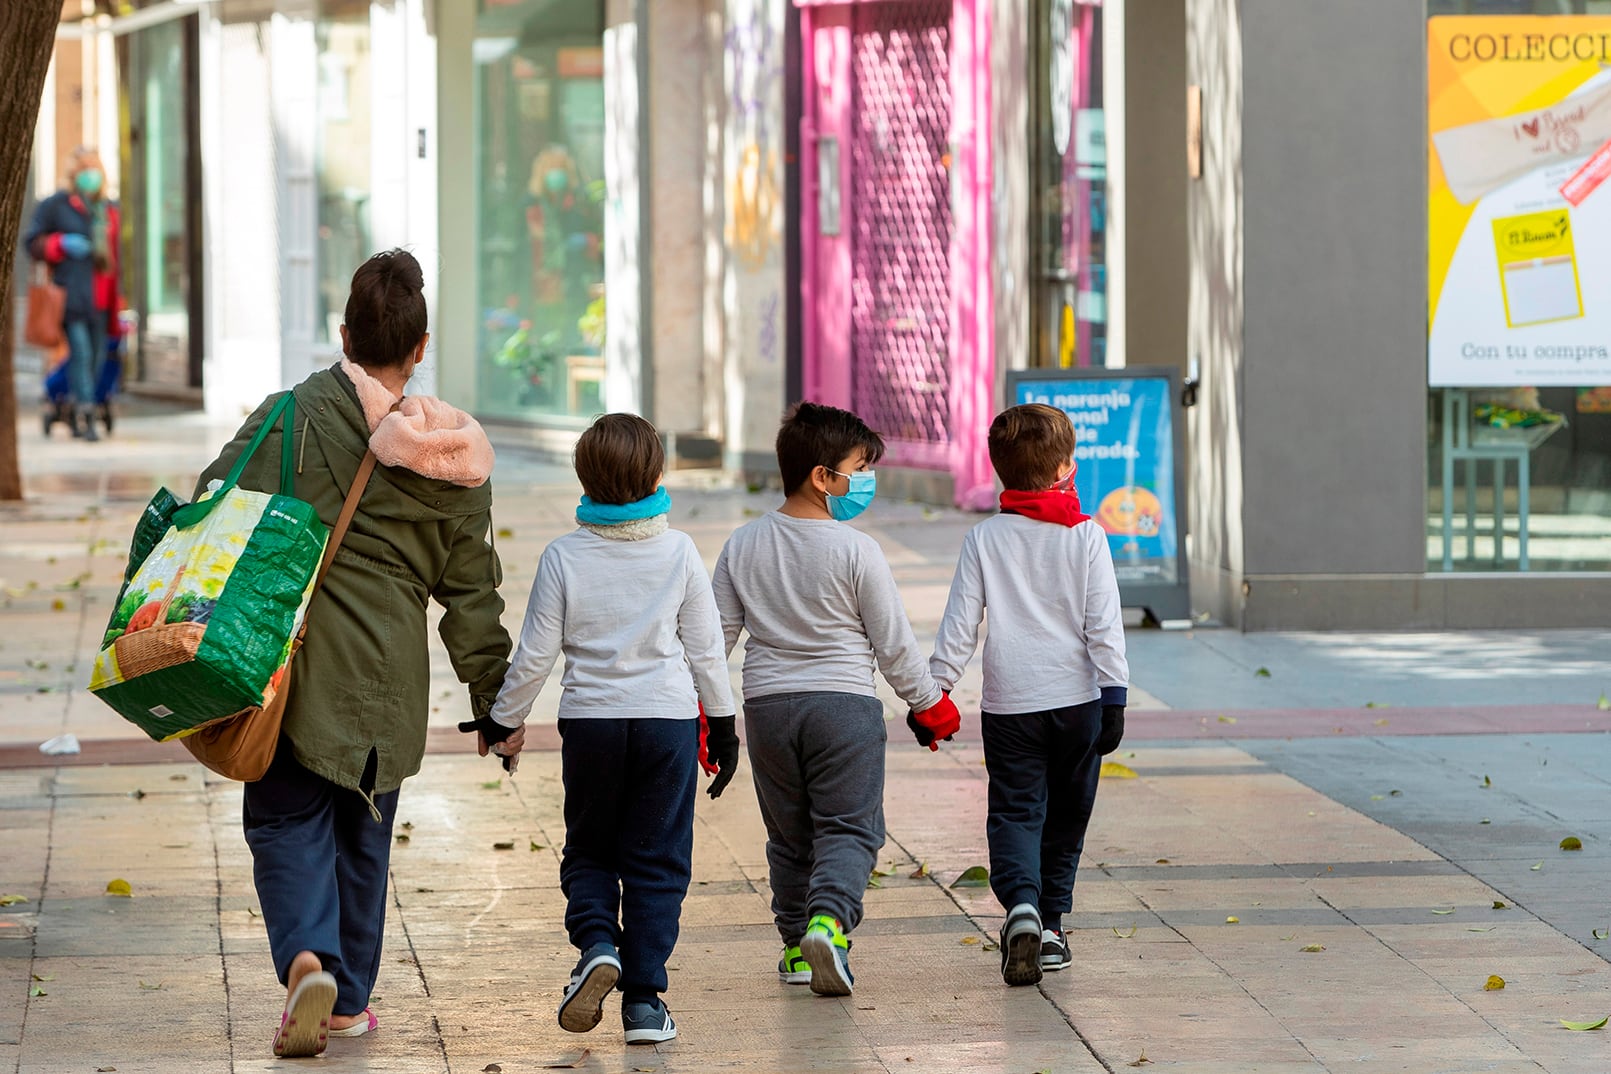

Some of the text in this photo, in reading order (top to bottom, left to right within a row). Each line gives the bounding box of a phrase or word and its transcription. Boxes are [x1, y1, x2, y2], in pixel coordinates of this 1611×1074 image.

[1449, 34, 1611, 62] COLECCI
[1461, 342, 1608, 363] Con tu compra
[1053, 389, 1131, 411] naranja
[1066, 406, 1109, 425] onal
[1074, 441, 1141, 459] orada.
